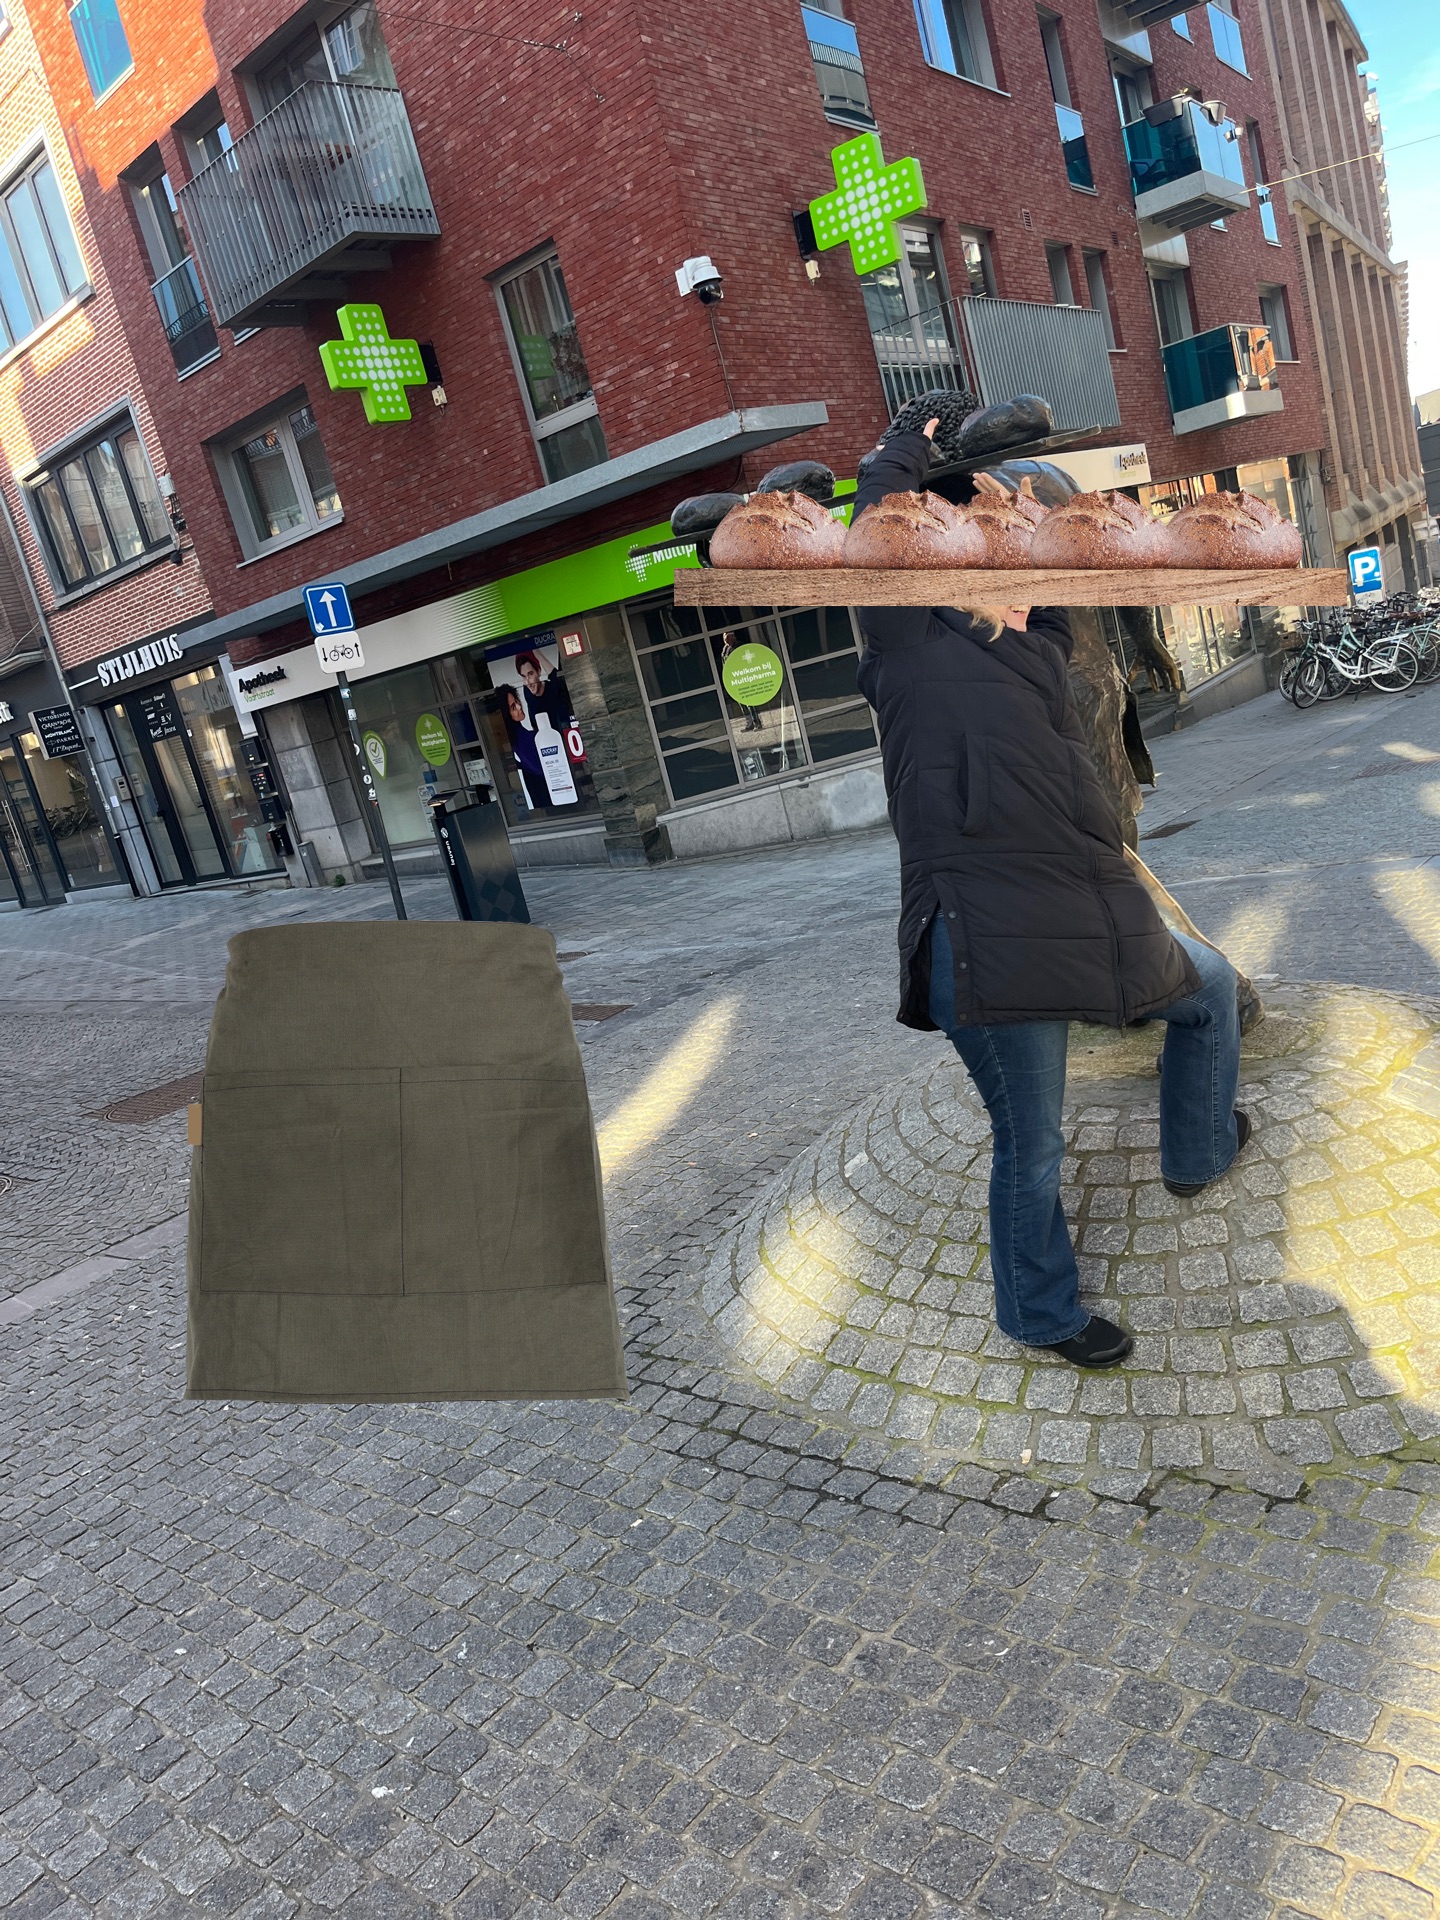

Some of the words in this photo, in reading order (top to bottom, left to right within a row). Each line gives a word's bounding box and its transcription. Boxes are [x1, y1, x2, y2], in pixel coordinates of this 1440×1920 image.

[1353, 556, 1376, 583] P
[97, 633, 183, 687] STIJLHUIS
[731, 665, 761, 678] Welkom
[762, 661, 772, 670] bij
[238, 665, 287, 694] Apotheek
[731, 670, 776, 687] Multipharma
